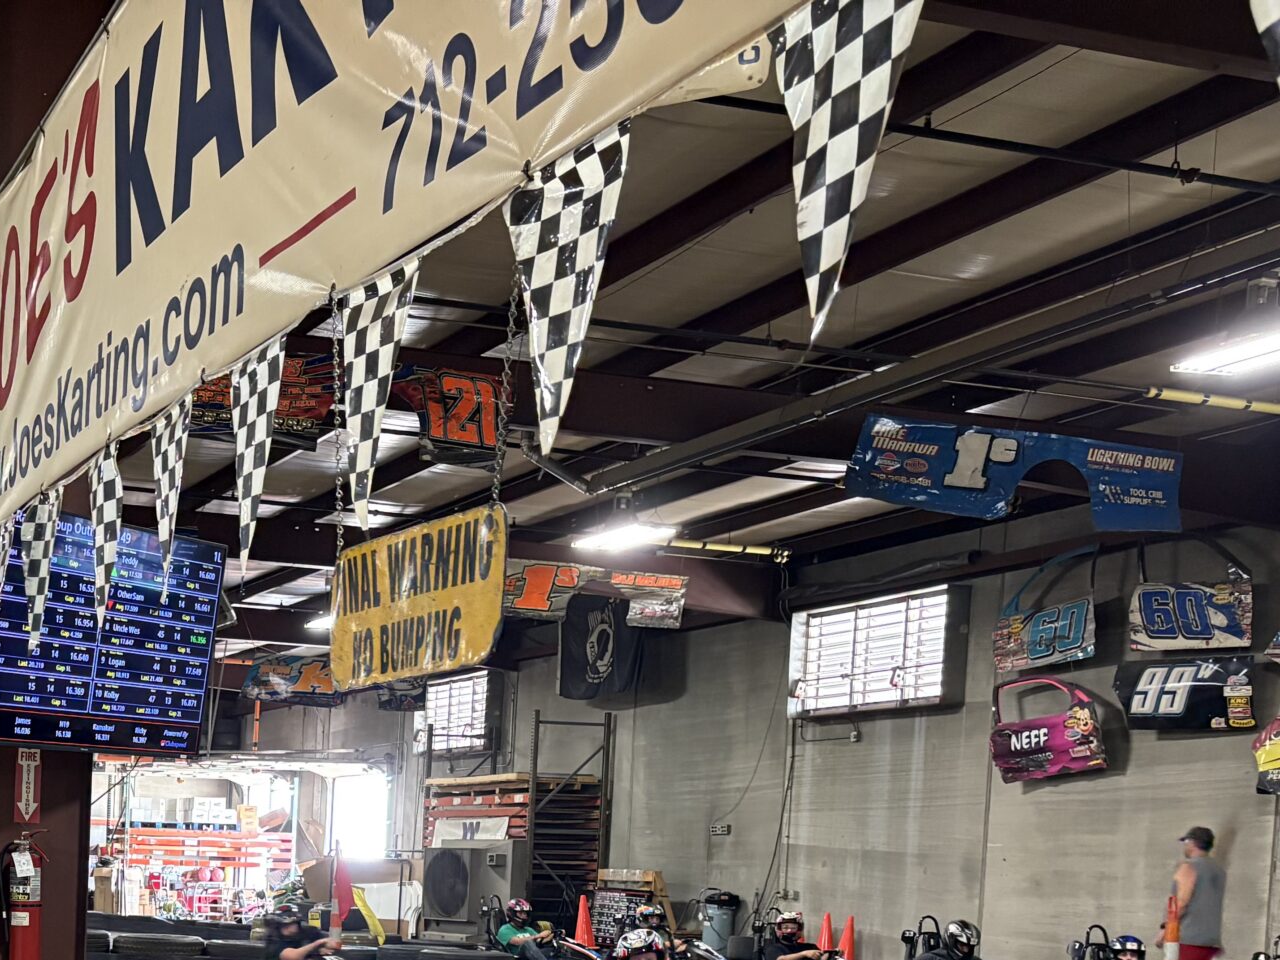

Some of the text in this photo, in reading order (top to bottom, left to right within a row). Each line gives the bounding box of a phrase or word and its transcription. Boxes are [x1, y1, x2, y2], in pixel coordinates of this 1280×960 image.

[428, 375, 497, 447] 121
[871, 437, 939, 456] MANAWA
[1087, 448, 1142, 467] LIGHTNING
[1143, 456, 1176, 472] BOWL
[1129, 488, 1147, 497] TOOL
[121, 555, 139, 568] Teddy
[386, 512, 495, 603] WARNING
[117, 589, 145, 602] OtherSam
[1140, 588, 1215, 639] 60
[113, 623, 128, 633] Uncle
[128, 625, 140, 635] Wes
[1027, 599, 1089, 660] 60
[352, 605, 463, 681] NO BUMPING
[108, 657, 126, 668] Logan
[1010, 727, 1050, 752] NEFF
[20, 751, 38, 762] FIRE
